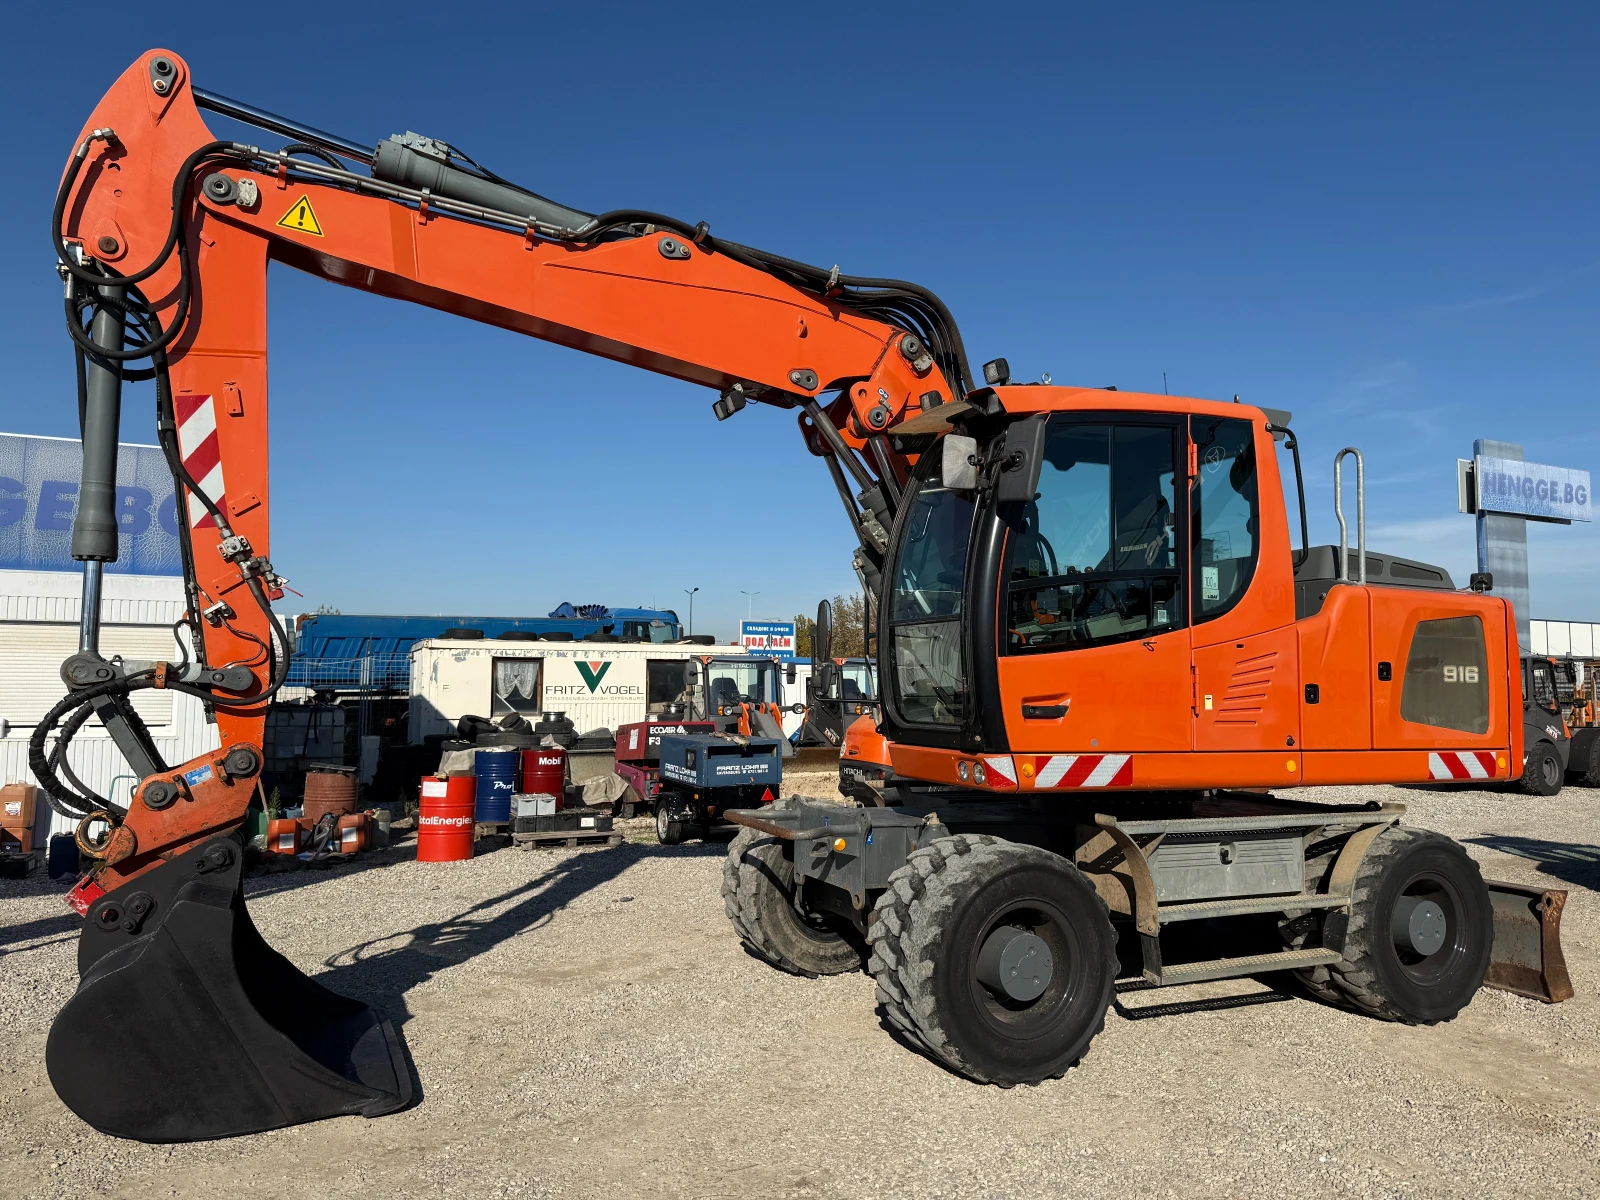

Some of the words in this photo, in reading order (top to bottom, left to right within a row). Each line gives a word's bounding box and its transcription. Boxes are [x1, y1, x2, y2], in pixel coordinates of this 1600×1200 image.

[1483, 471, 1587, 506] HENGGE.BG
[745, 637, 764, 648] ПОД
[767, 637, 791, 648] АЕМ
[1443, 665, 1479, 684] 916
[545, 685, 586, 695] FRITZ
[600, 685, 645, 695] VOGEL
[649, 726, 676, 734] ECOAIR
[539, 757, 562, 766] Mobil
